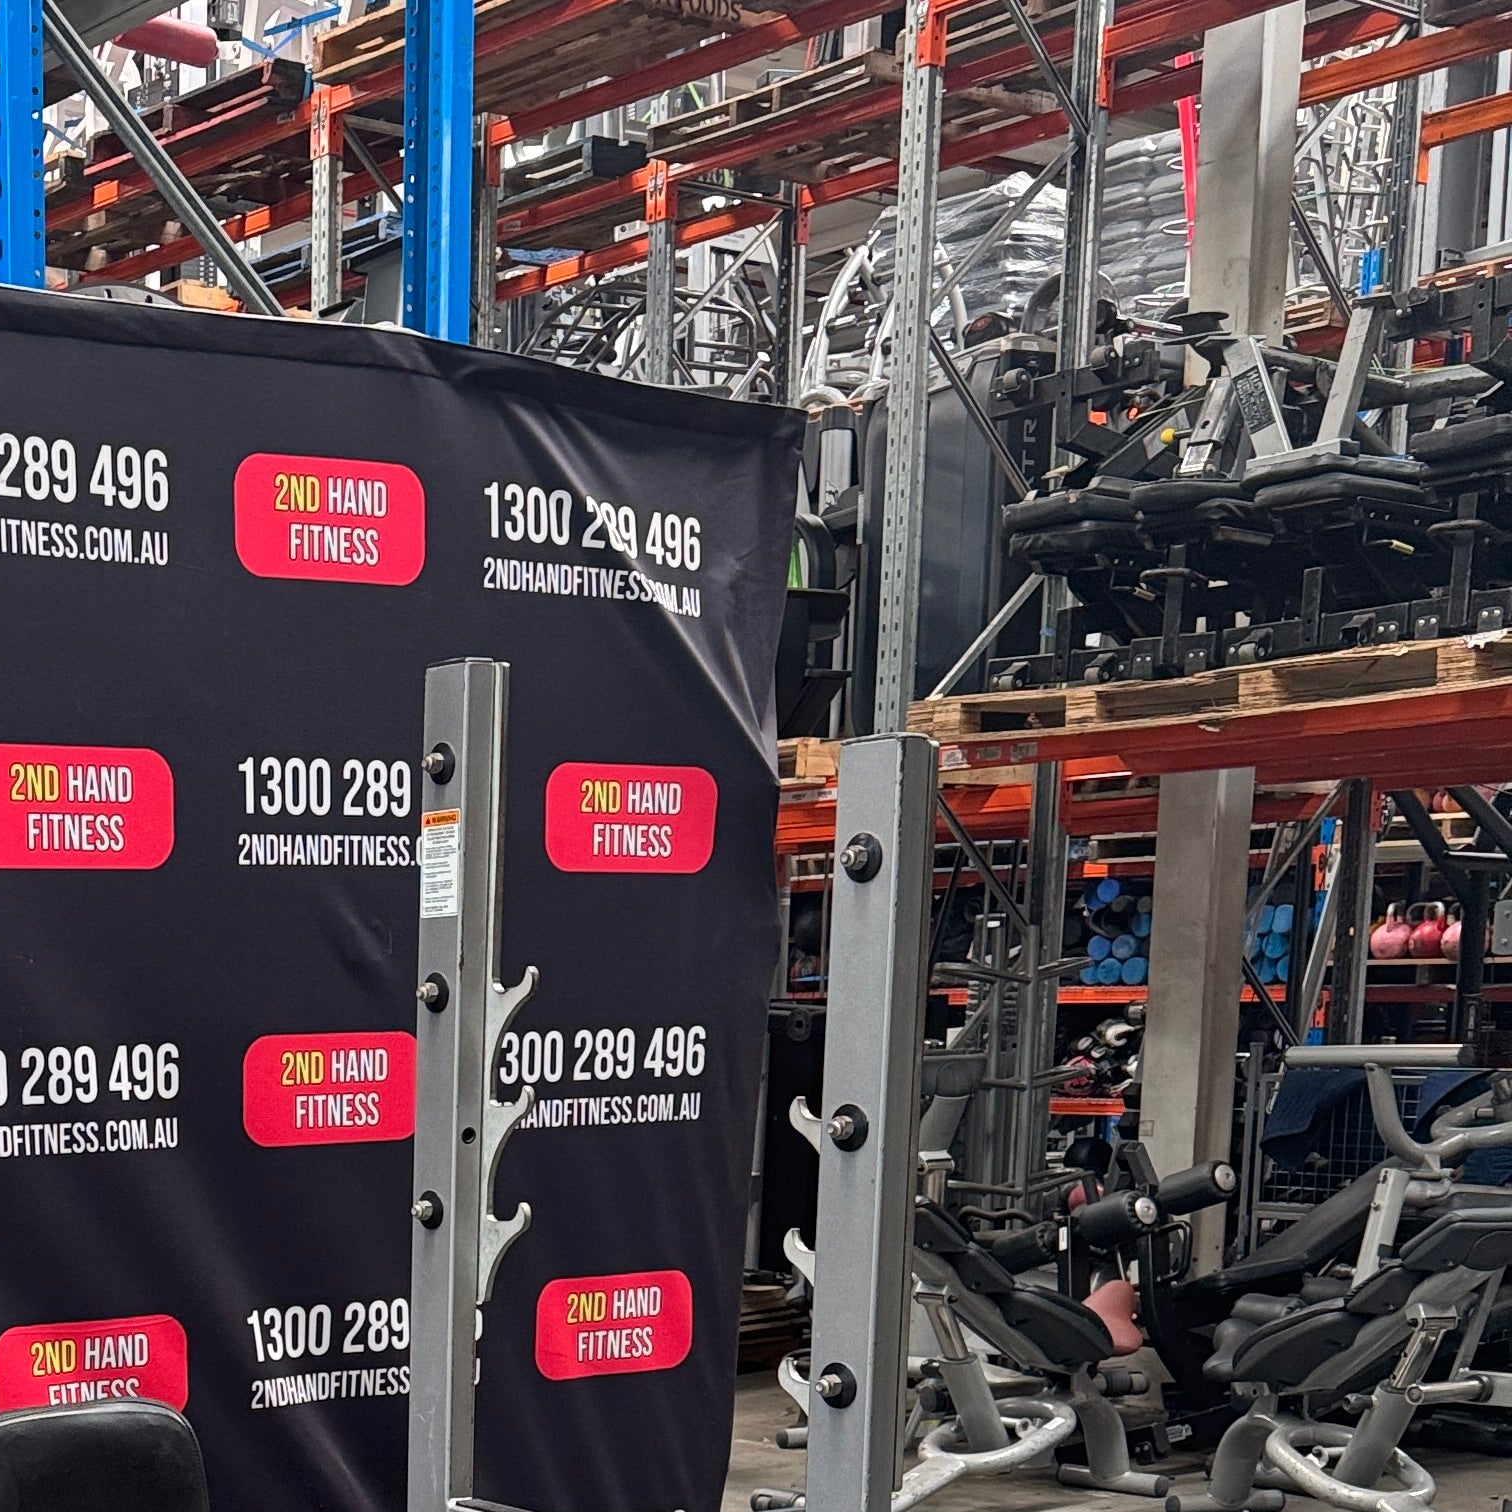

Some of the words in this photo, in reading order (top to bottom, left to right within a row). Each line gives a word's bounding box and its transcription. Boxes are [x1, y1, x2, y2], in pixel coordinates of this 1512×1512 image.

[89, 444, 169, 512] 496
[275, 473, 320, 513] 2ND
[328, 477, 387, 517] HAND
[290, 523, 379, 566] FITNESS
[483, 481, 573, 546] 1300
[581, 495, 638, 560] 289
[645, 511, 701, 572] 496
[10, 763, 59, 801] 2ND
[67, 765, 132, 803] HAND
[238, 756, 331, 816] 1300
[342, 758, 411, 818] 289
[581, 780, 621, 813] 2ND
[627, 781, 682, 815] HAND
[27, 813, 124, 852] FITNESS
[593, 823, 672, 858] FITNESS
[20, 1045, 98, 1106] 289
[108, 1042, 180, 1101] 496
[281, 1051, 324, 1086] 2ND
[331, 1048, 388, 1083] HAND
[500, 1030, 564, 1085] 300
[573, 1027, 636, 1081] 289
[643, 1025, 707, 1078] 496
[296, 1092, 380, 1128] FITNESS
[567, 1291, 607, 1324] 2ND
[612, 1286, 661, 1320] HAND
[246, 1304, 332, 1363] 1300
[342, 1297, 410, 1355] 289
[578, 1326, 653, 1362] FITNESS
[30, 1340, 76, 1376] 2ND
[84, 1333, 149, 1370] HAND
